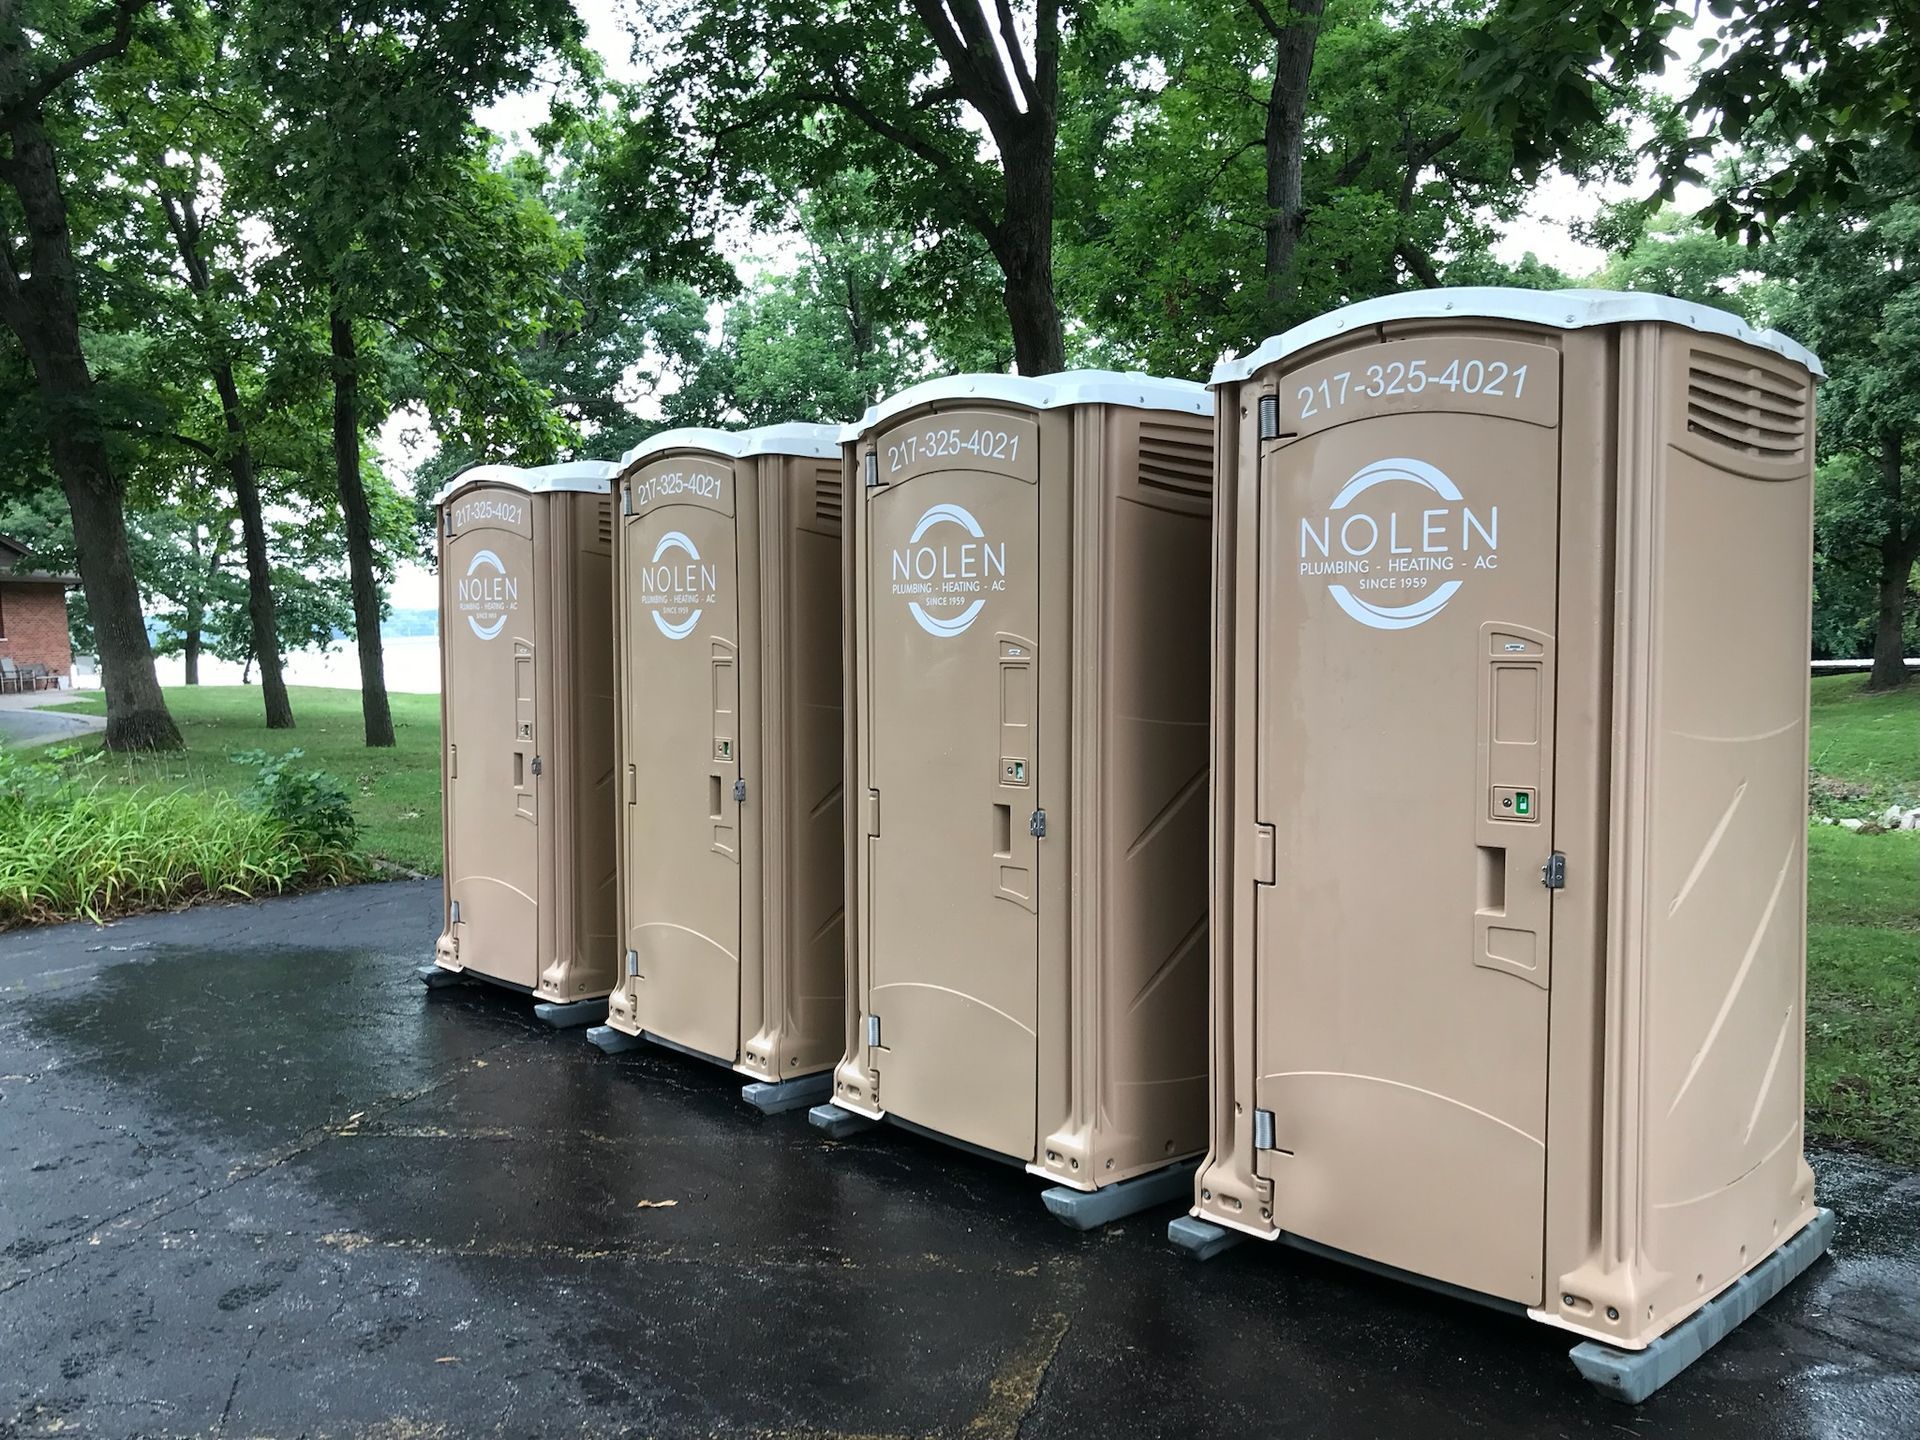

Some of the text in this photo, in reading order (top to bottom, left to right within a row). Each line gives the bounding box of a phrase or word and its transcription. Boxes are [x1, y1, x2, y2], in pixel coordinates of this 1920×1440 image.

[1297, 359, 1528, 419] 217-325-4021
[888, 429, 1020, 472] 217-325-4021
[638, 472, 721, 506] 217-325-4021
[456, 501, 522, 527] 217-325-4021
[1301, 506, 1497, 558] NOLEN
[892, 542, 1006, 581] NOLEN
[1300, 560, 1370, 576] PLUMBING
[1388, 556, 1454, 573] HEATING
[1474, 555, 1498, 570] AC
[459, 577, 518, 601] NOLEN
[642, 564, 717, 593] NOLEN
[892, 582, 932, 595] PLUMBING
[942, 580, 980, 592] HEATING
[991, 579, 1006, 591] AC
[1359, 577, 1428, 590] SINCE 1959
[510, 601, 518, 610] AC
[663, 606, 677, 615] SINCE
[673, 593, 699, 604] HEATING
[706, 593, 716, 603] AC
[926, 597, 965, 606] SINCE 1959
